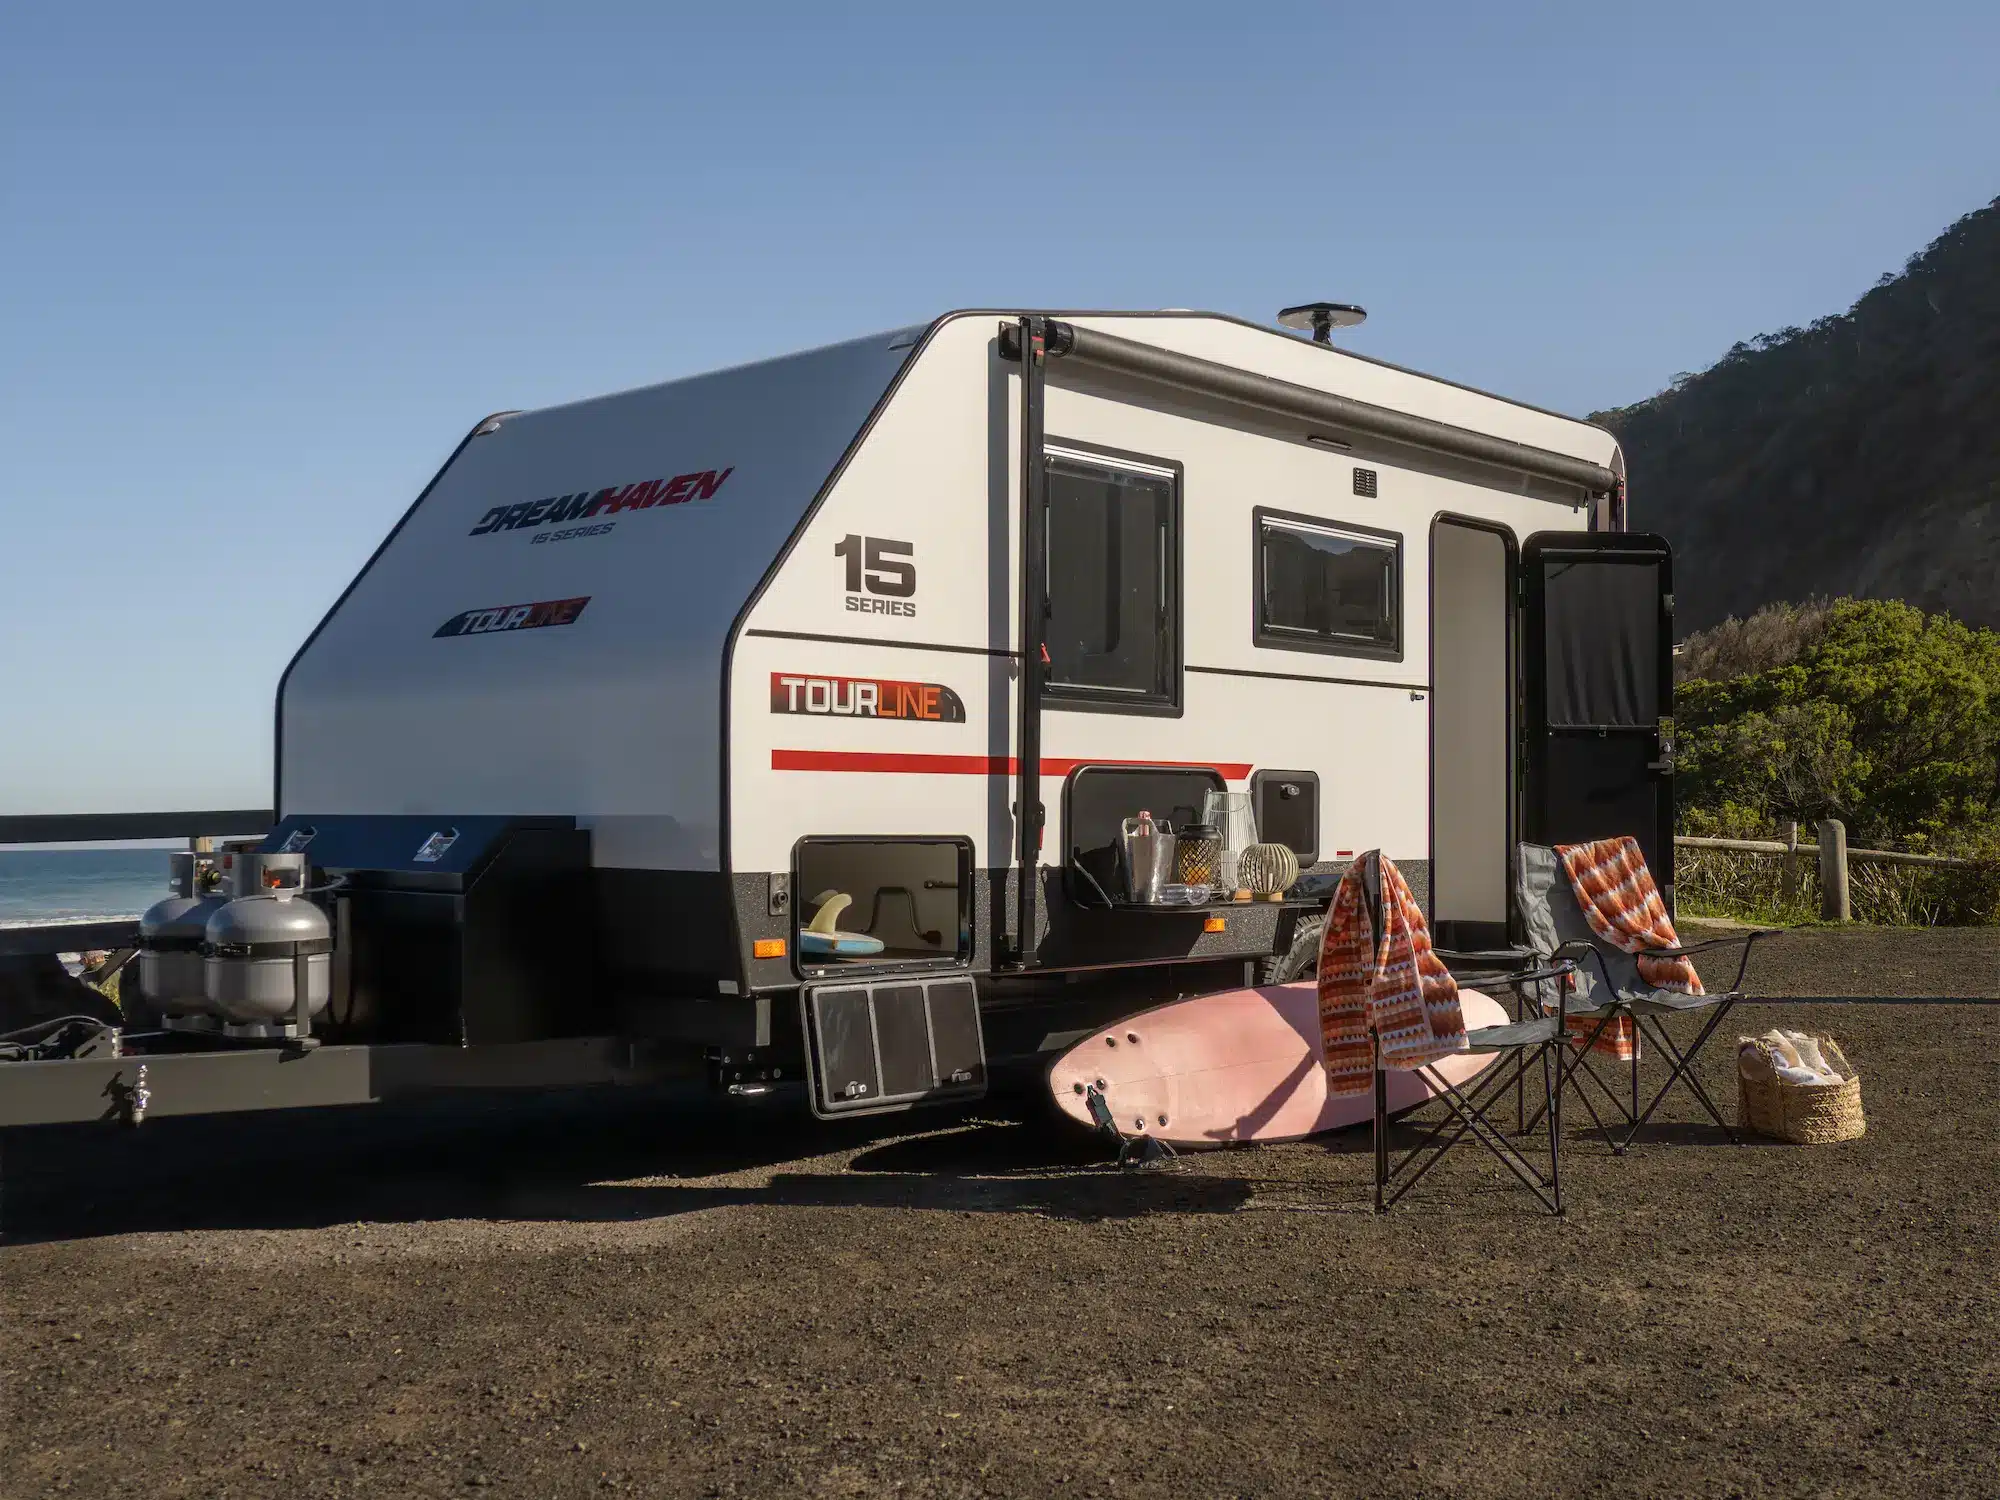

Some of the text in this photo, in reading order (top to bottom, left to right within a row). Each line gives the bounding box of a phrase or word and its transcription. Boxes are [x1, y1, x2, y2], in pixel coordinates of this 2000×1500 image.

[468, 466, 735, 536] DREAMHAVEN
[529, 522, 617, 545] 15 SERIES
[835, 534, 916, 598] 15
[846, 596, 916, 618] SERIES
[781, 677, 941, 719] TOURLINE
